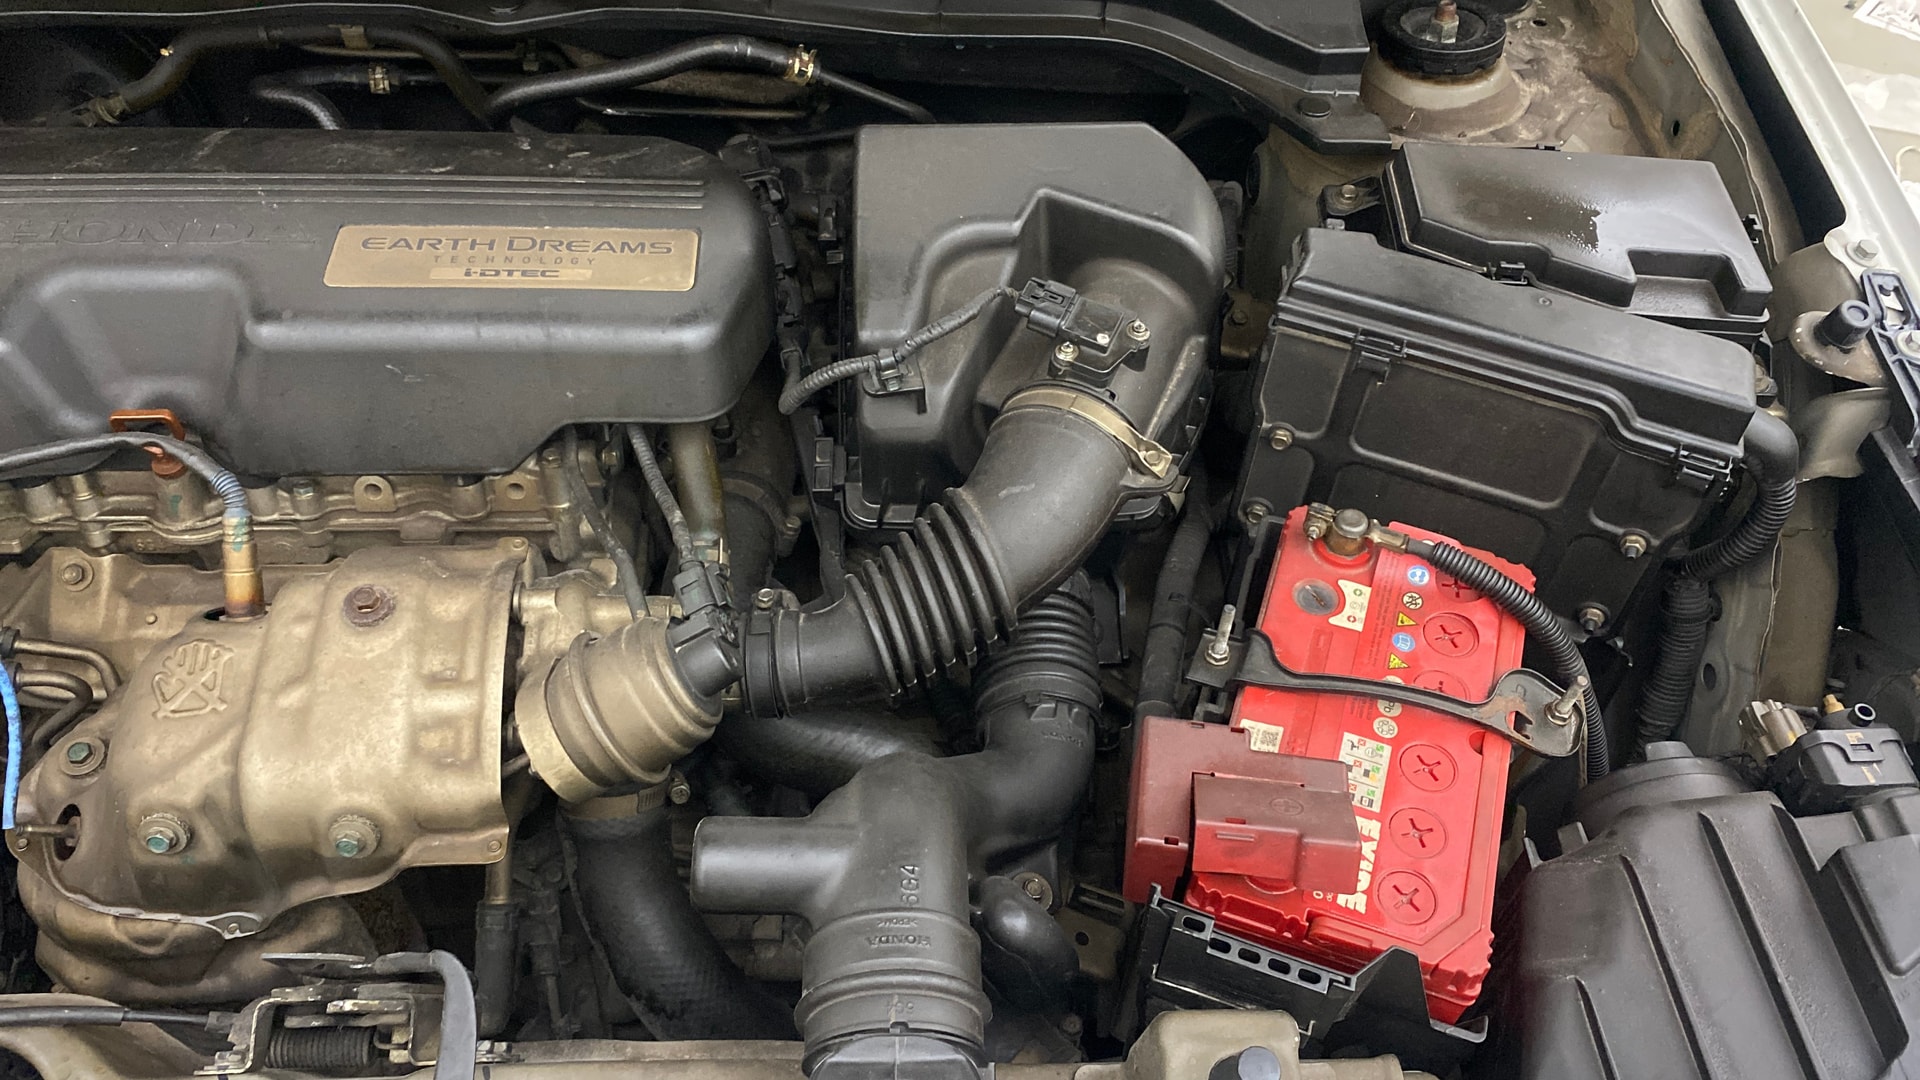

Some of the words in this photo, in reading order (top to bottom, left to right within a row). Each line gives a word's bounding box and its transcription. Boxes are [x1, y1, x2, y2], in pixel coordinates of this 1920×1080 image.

[361, 236, 496, 252] EARTH
[507, 235, 674, 255] DREAMS
[434, 255, 597, 266] TECHNOLOGY
[865, 934, 931, 949] HONDA
